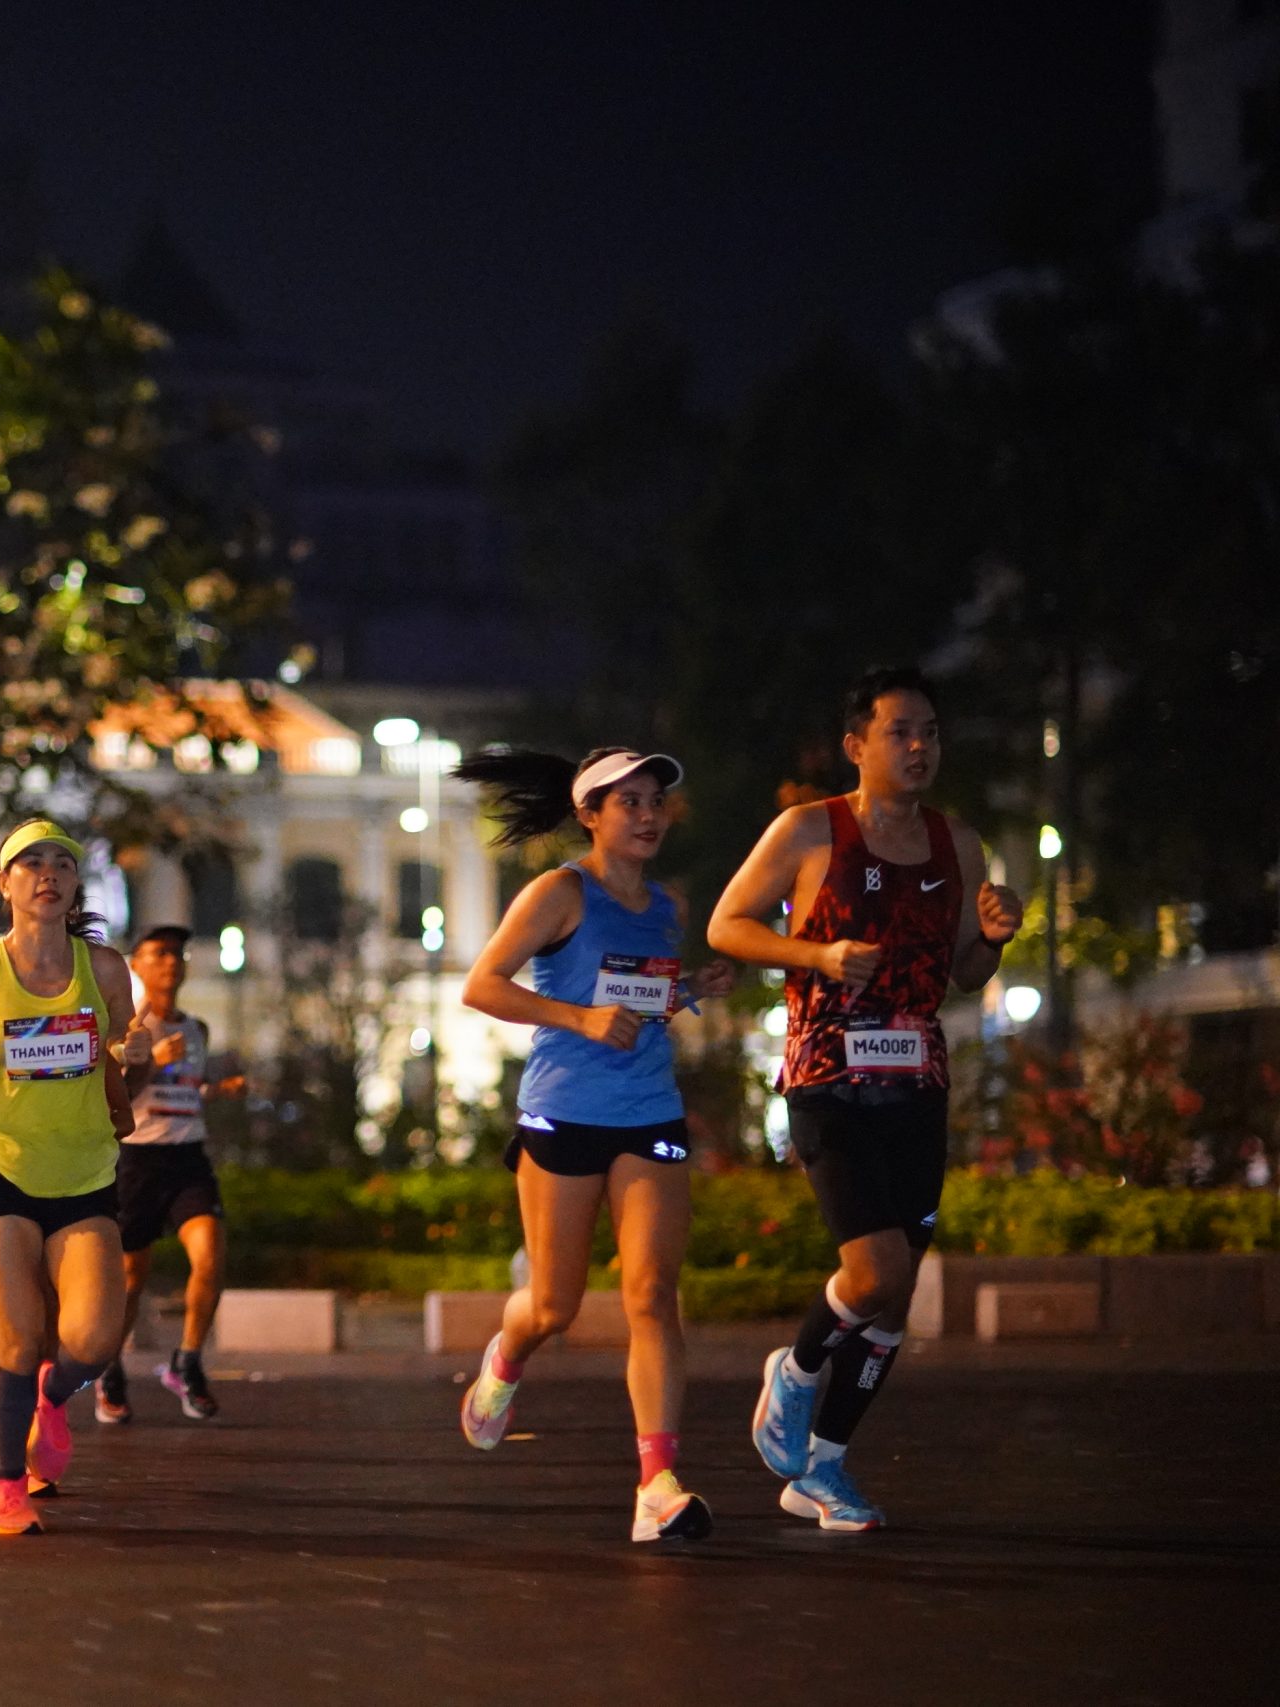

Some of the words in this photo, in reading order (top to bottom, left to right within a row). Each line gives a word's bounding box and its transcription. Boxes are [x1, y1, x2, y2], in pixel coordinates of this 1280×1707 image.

[606, 983, 630, 996] HOA
[634, 986, 662, 999] TRAN
[10, 1044, 55, 1059] THANH
[57, 1042, 84, 1055] TAM
[852, 1038, 917, 1055] M40087
